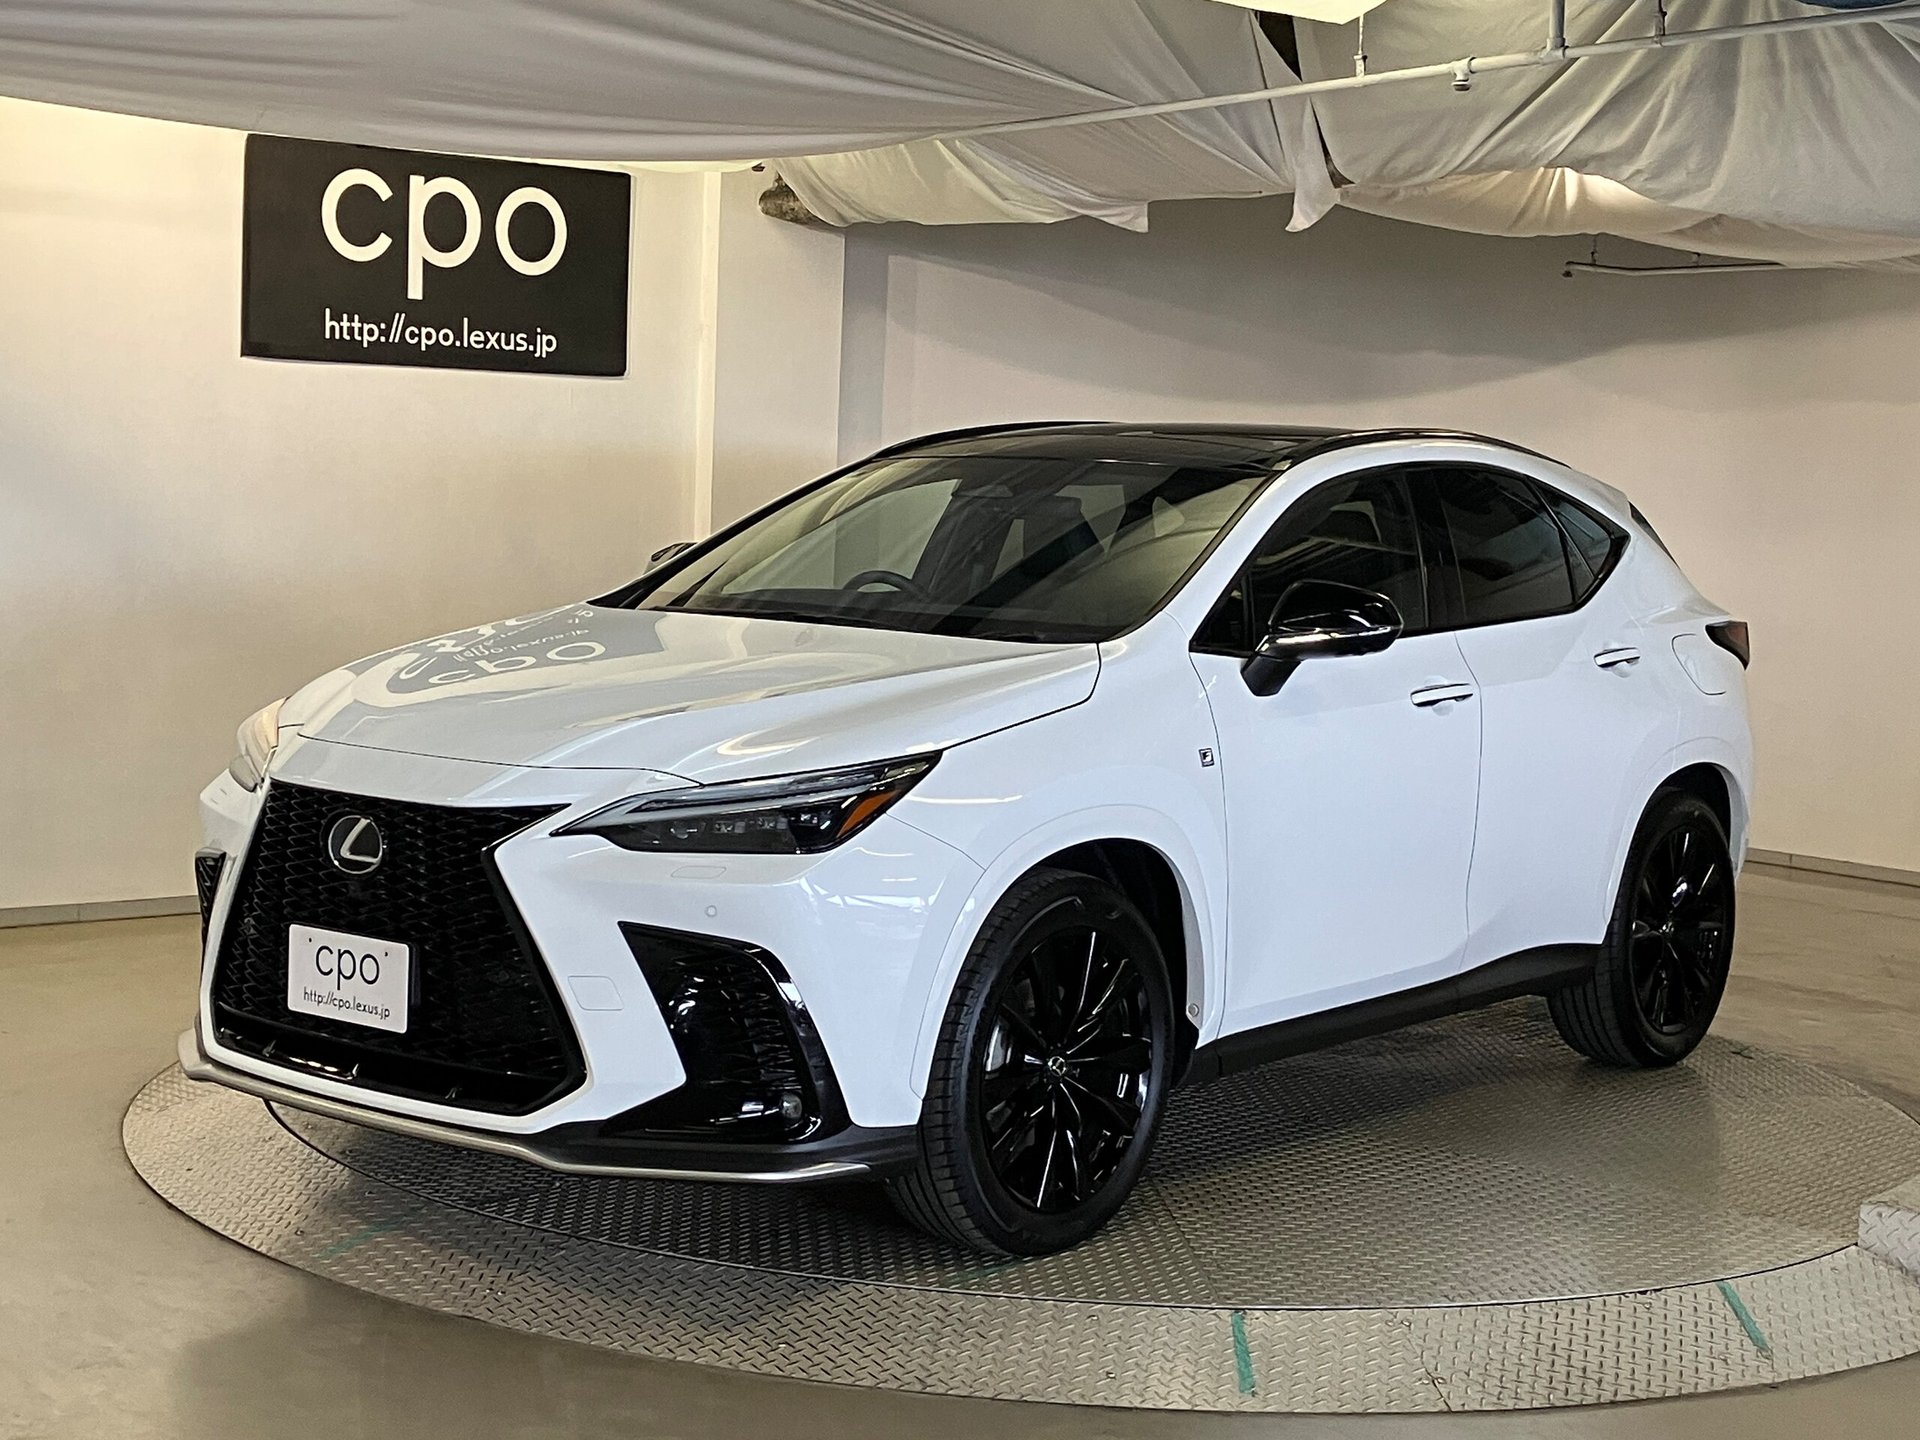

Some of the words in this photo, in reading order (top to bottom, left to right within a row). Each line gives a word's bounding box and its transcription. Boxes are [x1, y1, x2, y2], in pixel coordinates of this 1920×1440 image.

[321, 168, 568, 300] cpo
[324, 308, 557, 358] http://cpo.lexus.jp
[316, 945, 380, 991] cpo
[304, 986, 390, 1020] http://cpo.lexus.jp
